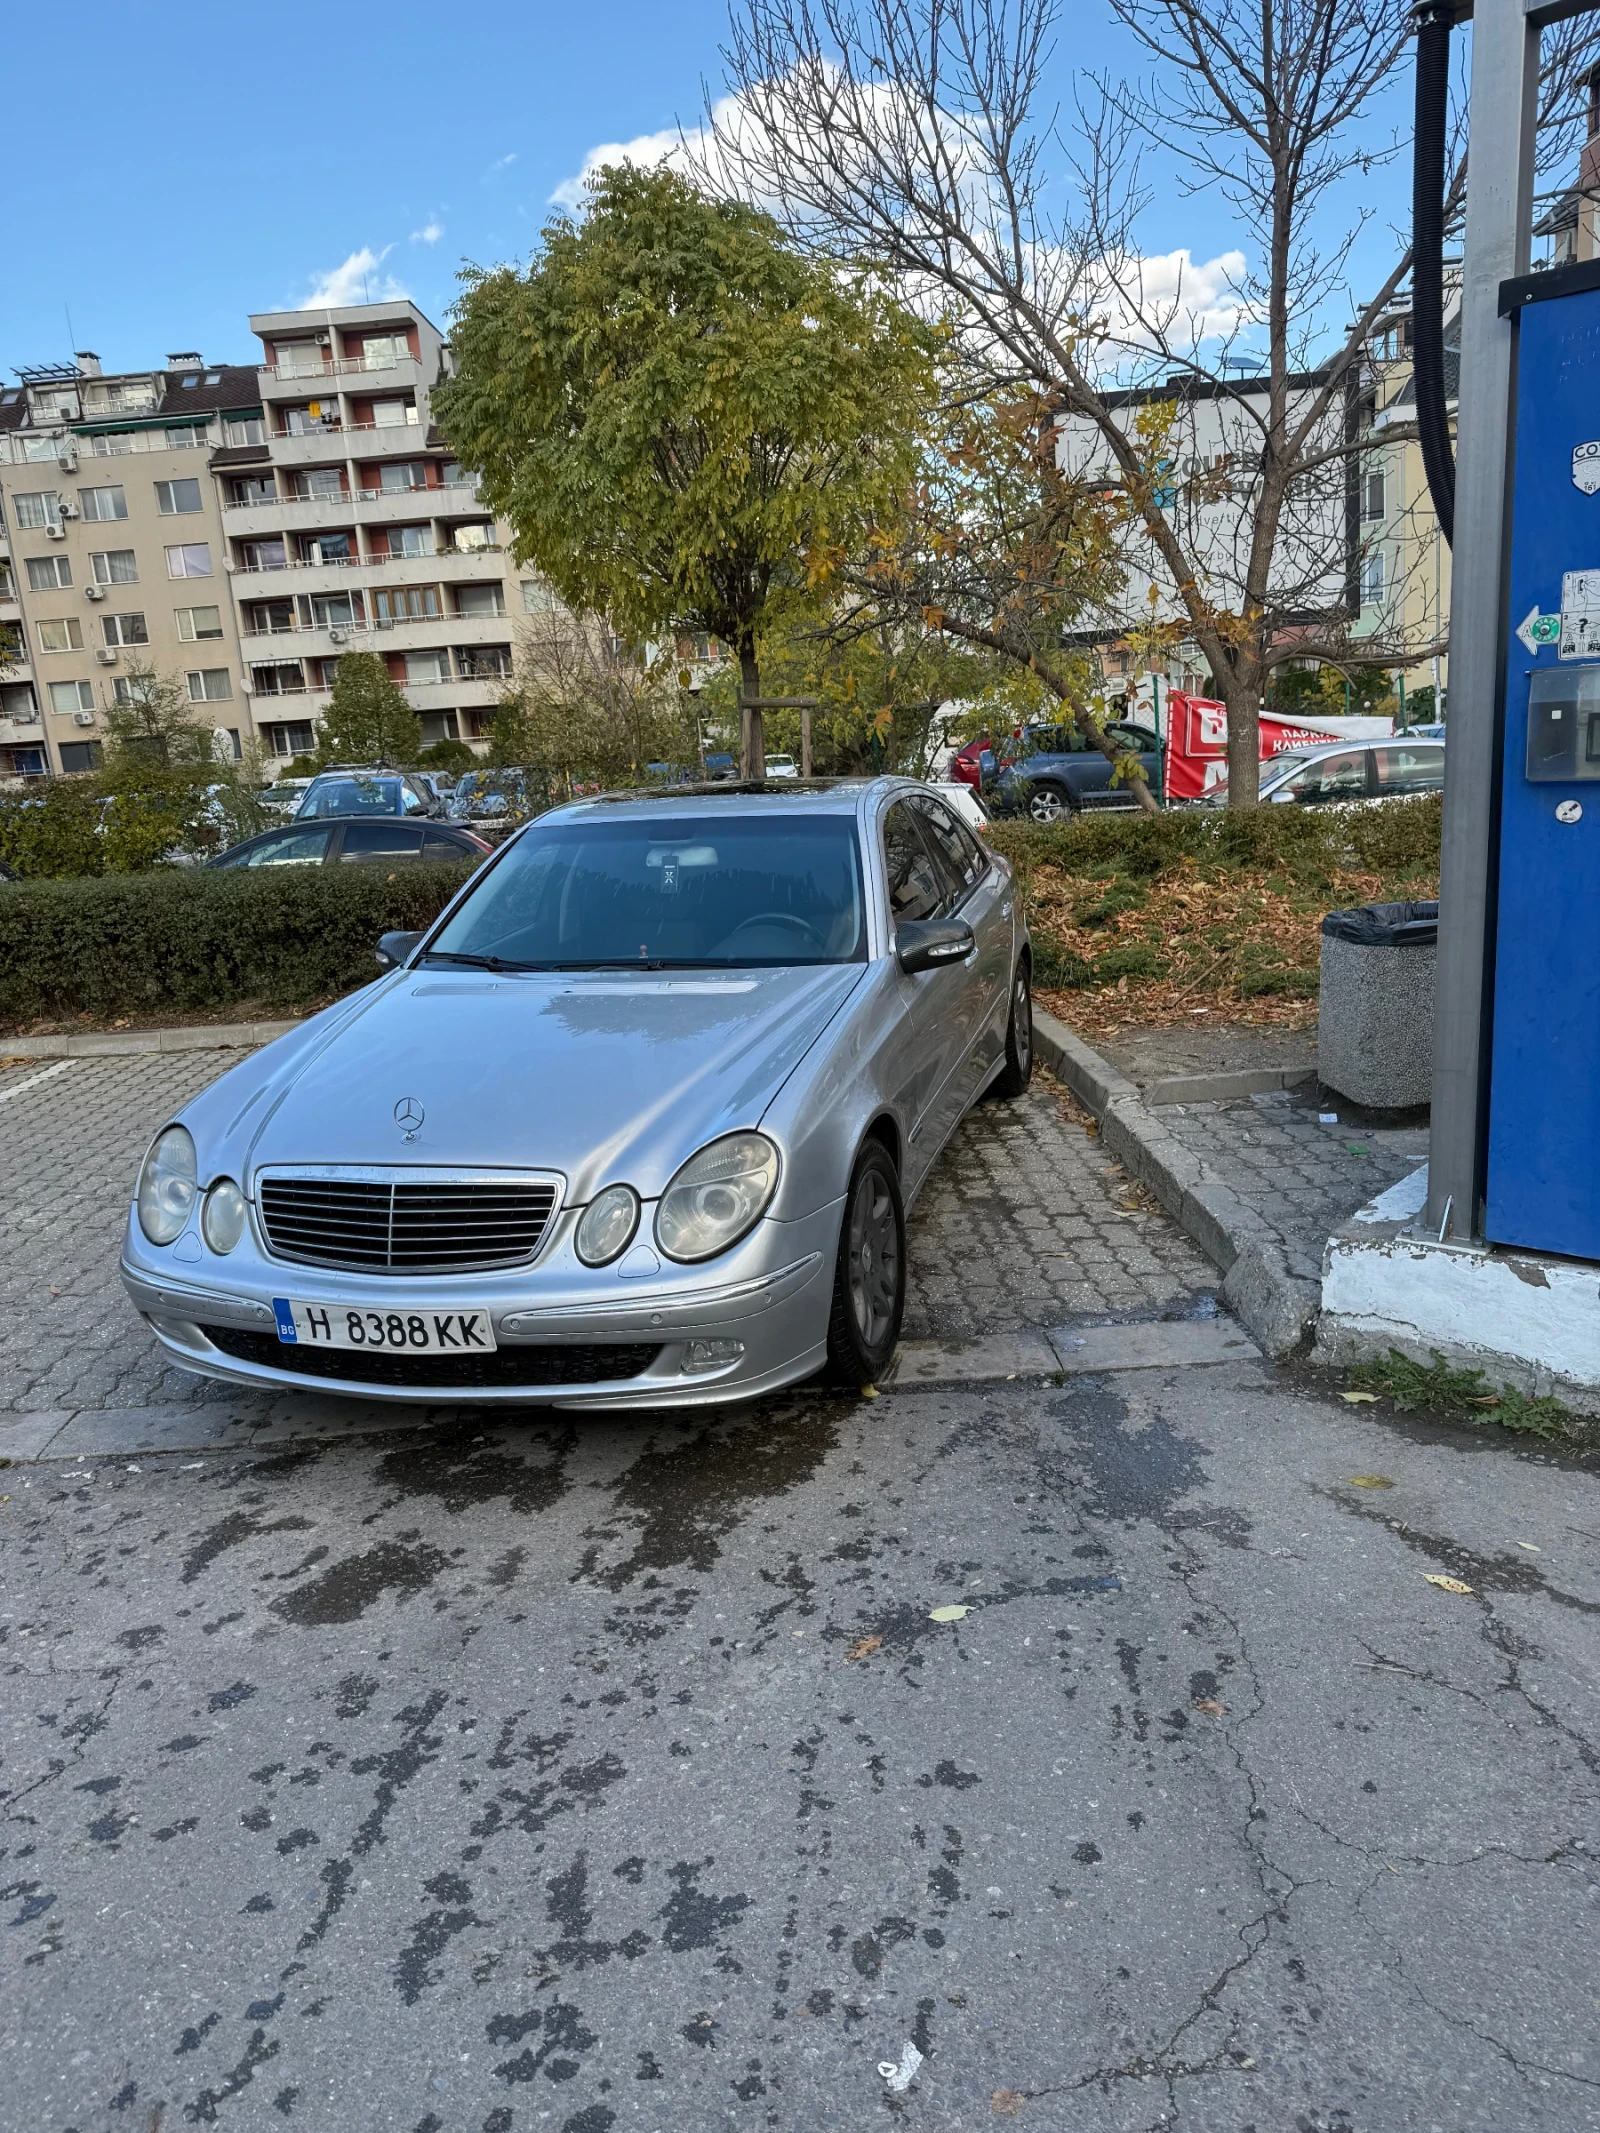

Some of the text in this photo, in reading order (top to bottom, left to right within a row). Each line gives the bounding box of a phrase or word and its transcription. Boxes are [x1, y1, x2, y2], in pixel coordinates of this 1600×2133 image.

[1575, 444, 1600, 458] CO
[1535, 616, 1558, 627] START
[1522, 625, 1532, 638] A
[1535, 632, 1556, 642] START
[281, 1324, 295, 1336] BG
[346, 1311, 429, 1348] 8388
